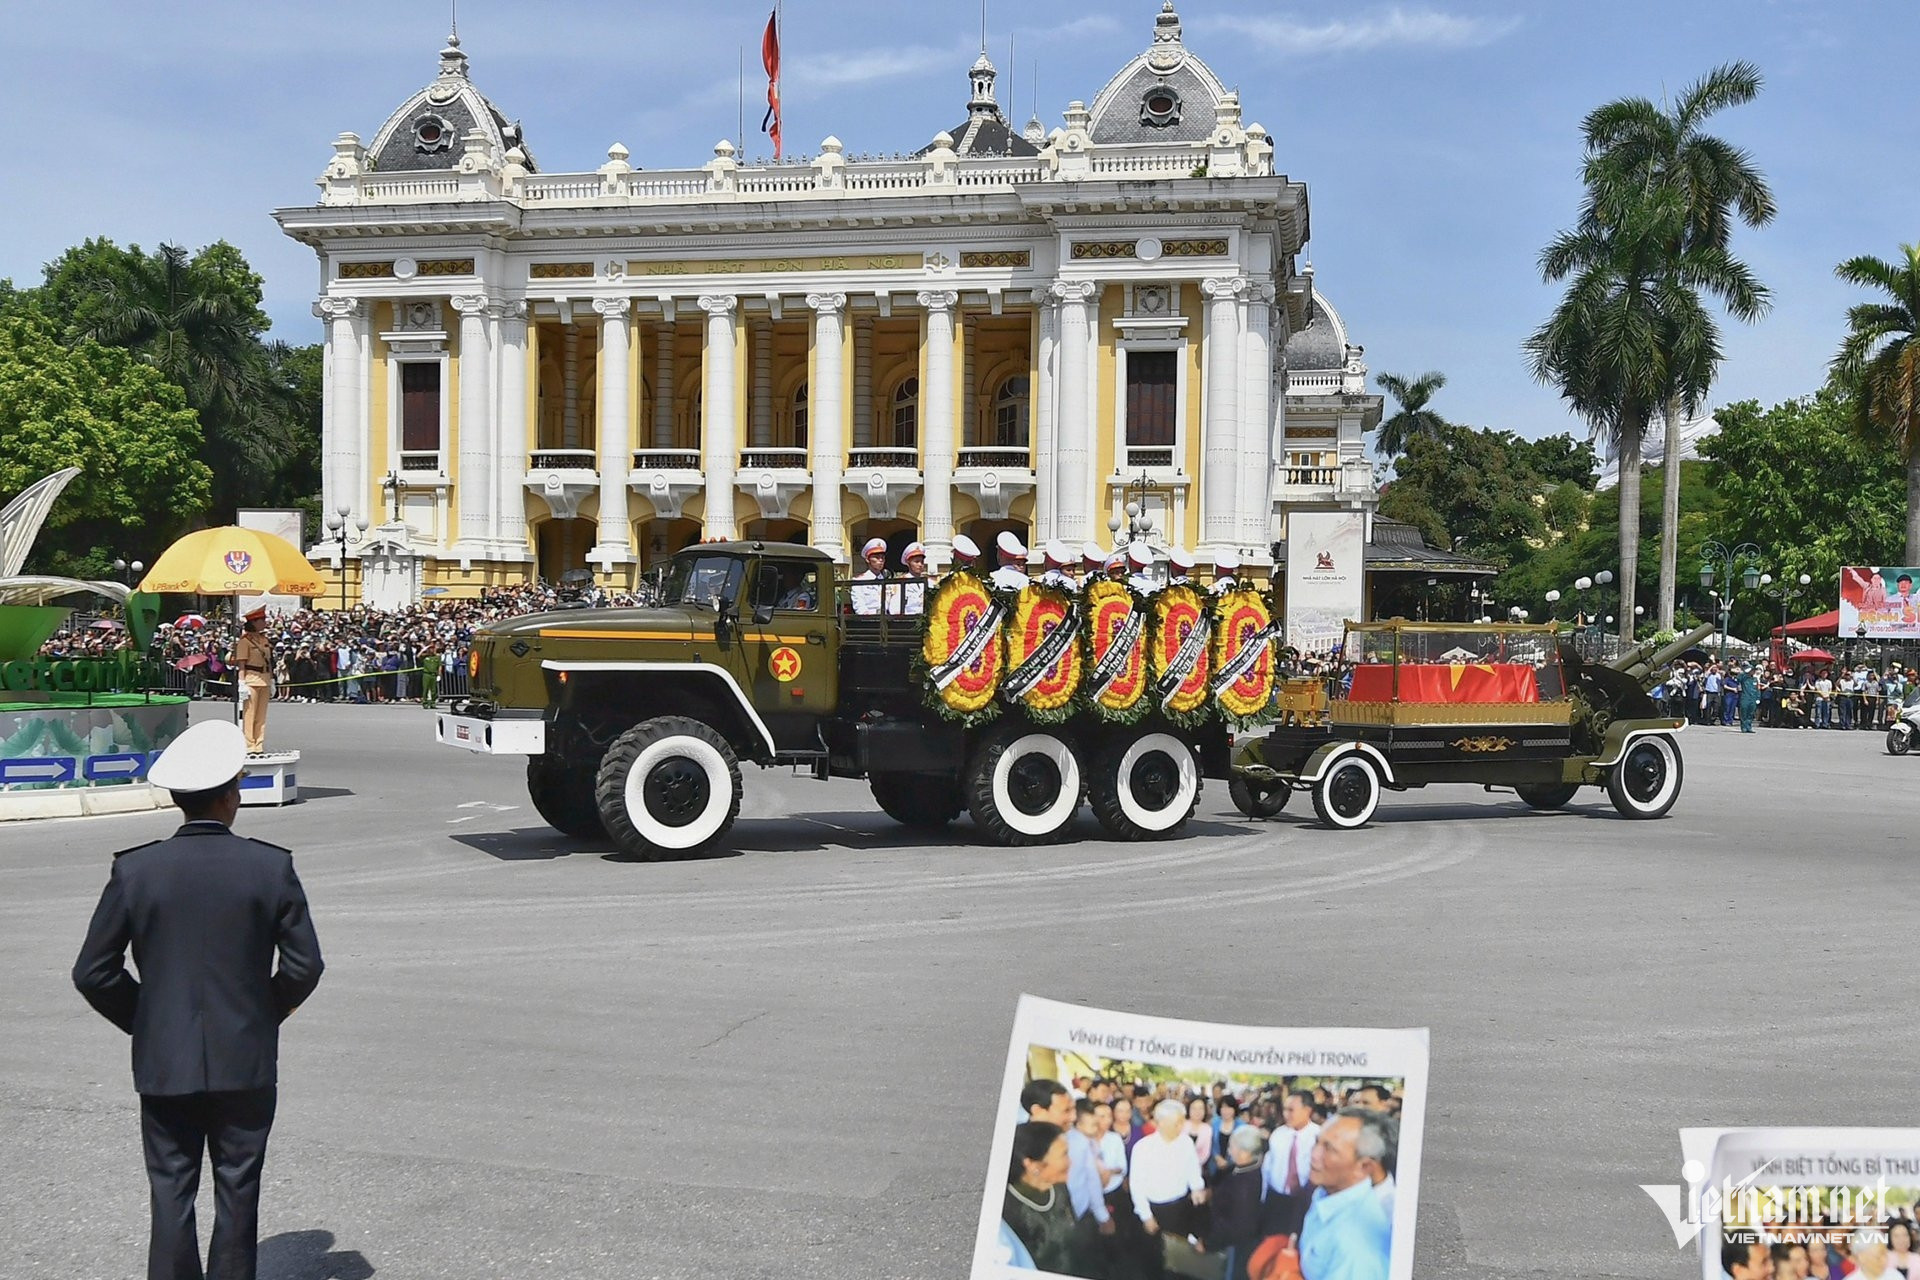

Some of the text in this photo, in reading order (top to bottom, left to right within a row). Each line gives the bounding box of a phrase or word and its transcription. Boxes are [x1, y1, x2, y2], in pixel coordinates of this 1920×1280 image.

[646, 261, 689, 275] NHÀ
[704, 260, 744, 273] HÁT
[821, 256, 849, 270] HÀ
[223, 580, 254, 590] CSGT
[286, 583, 311, 592] LPBank
[1069, 1028, 1103, 1047] VĨNH
[1106, 1034, 1134, 1052] BIỆT
[1180, 1041, 1195, 1058] BÍ
[1227, 1045, 1284, 1064] NGUYỄN
[1287, 1048, 1316, 1065] PHÚ
[1319, 1051, 1367, 1067] TRỌNG
[1786, 1157, 1813, 1176] BIỆT
[1866, 1156, 1882, 1175] BÍ
